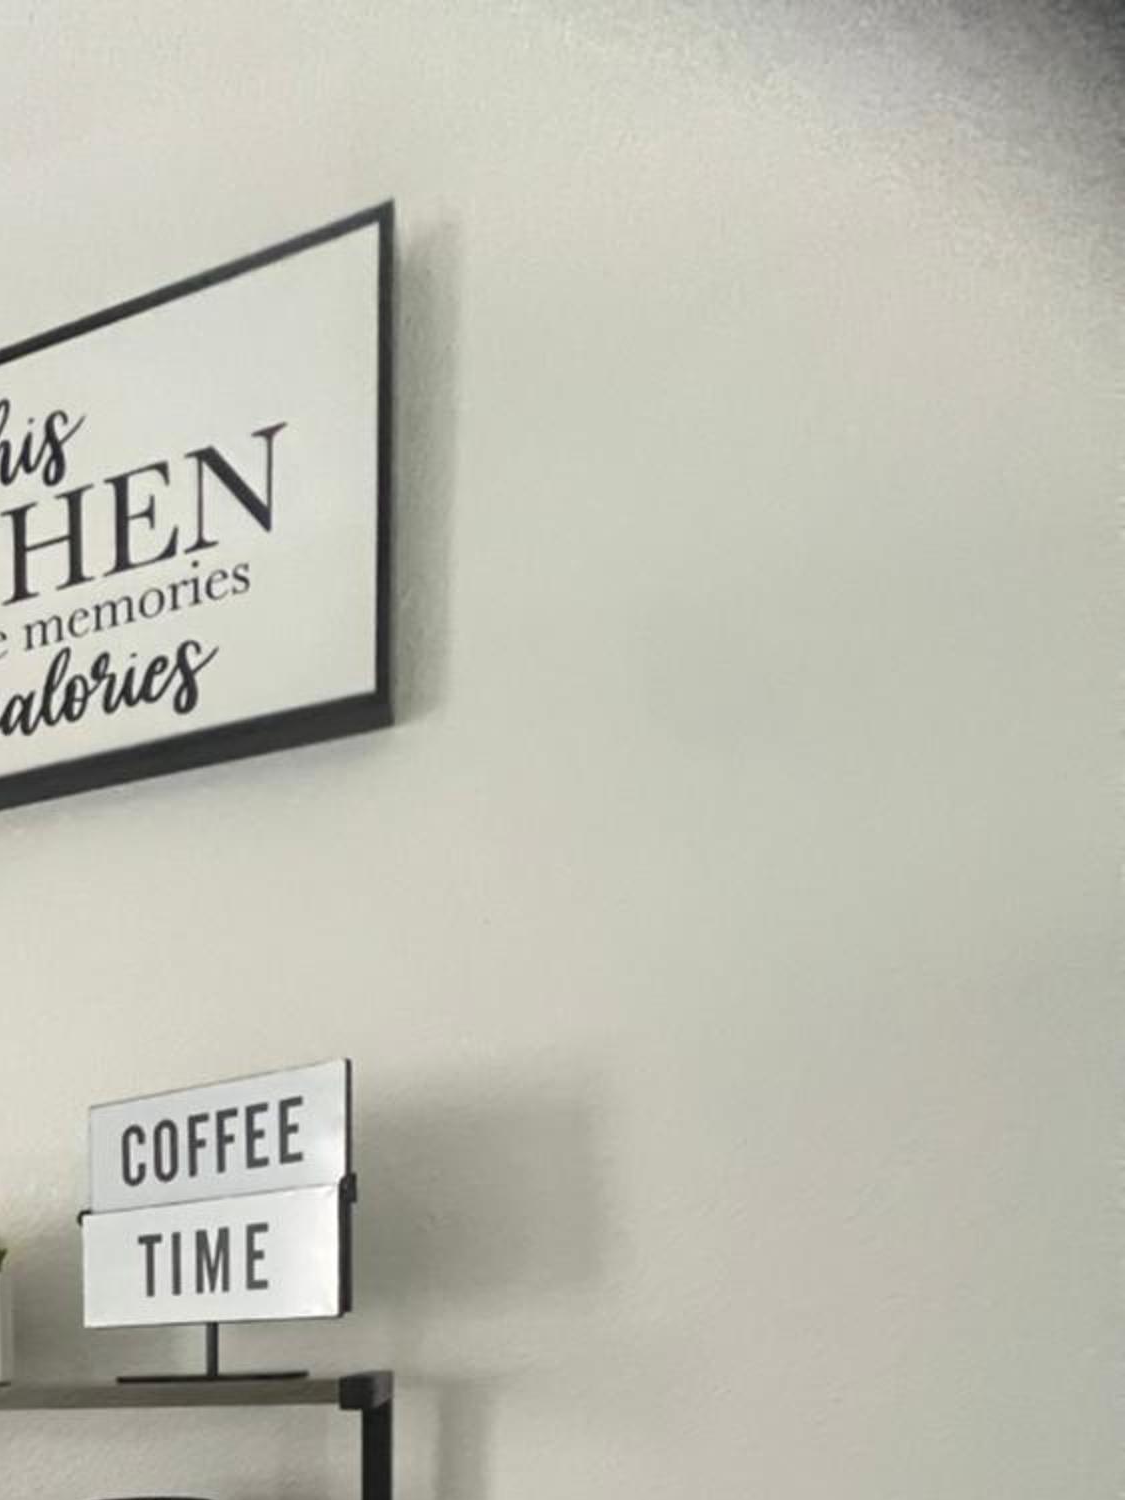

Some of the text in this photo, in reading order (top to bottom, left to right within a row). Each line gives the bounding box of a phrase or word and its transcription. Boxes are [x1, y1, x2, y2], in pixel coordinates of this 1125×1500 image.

[23, 559, 252, 652] memories
[121, 1095, 304, 1187] COFFEE
[137, 1221, 269, 1298] TIME
